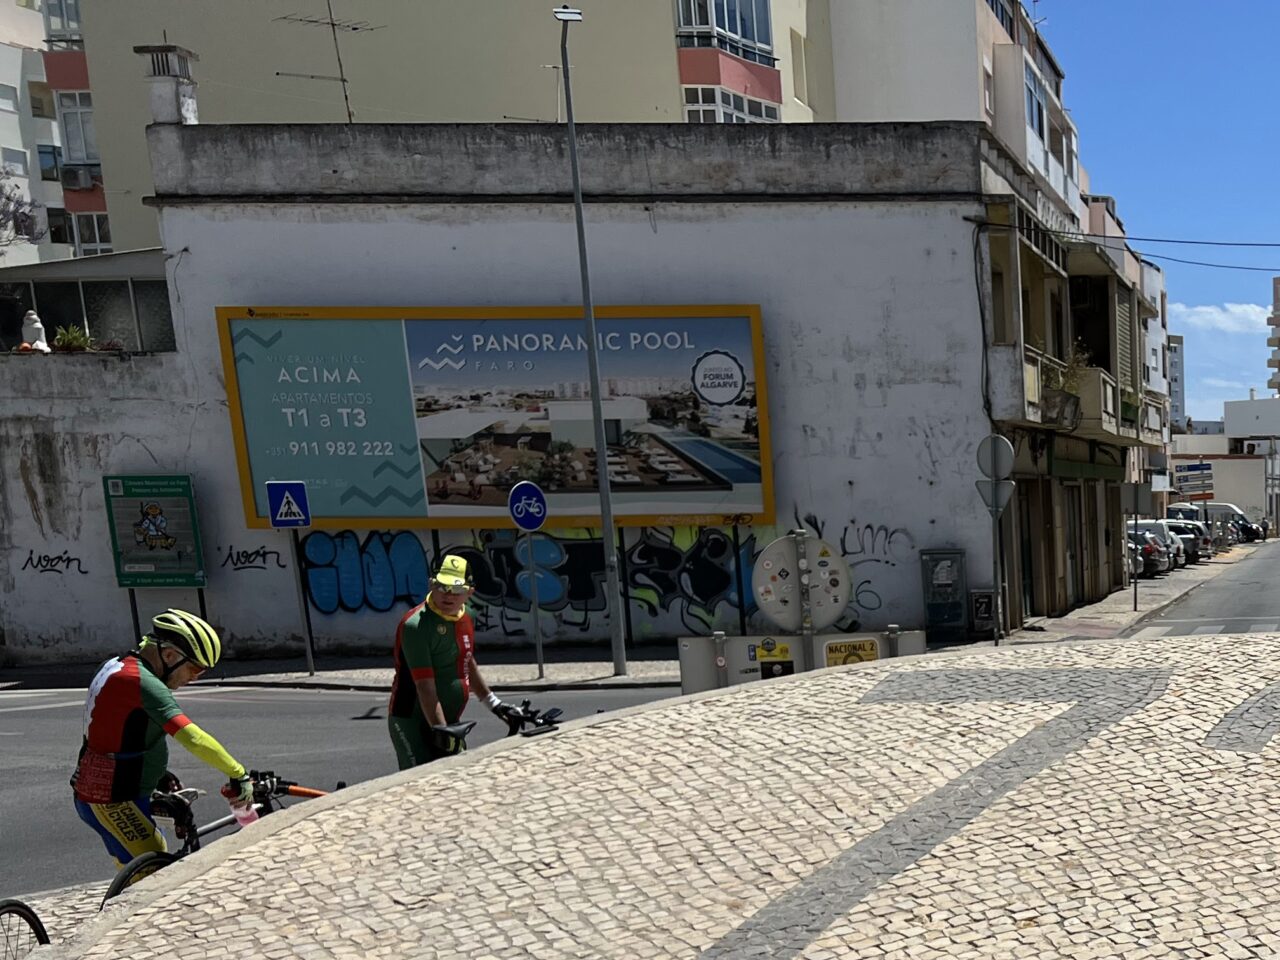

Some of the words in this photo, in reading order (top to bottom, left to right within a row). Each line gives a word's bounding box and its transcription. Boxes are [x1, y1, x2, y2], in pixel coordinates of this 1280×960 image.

[630, 331, 696, 350] POOL
[475, 360, 535, 371] FARO
[278, 366, 361, 383] ACIMA
[703, 373, 734, 381] FORUM
[700, 381, 739, 389] ALGARVE
[271, 392, 373, 405] APARTAMENTOS
[282, 408, 309, 427] T1
[319, 413, 332, 427] a
[337, 408, 367, 427] T3
[289, 441, 320, 456] 911
[326, 441, 357, 456] 982
[363, 441, 395, 456] 222
[828, 643, 867, 654] NACIONAL
[869, 642, 875, 651] 2
[108, 811, 139, 842] CYCLES
[120, 806, 152, 841] CAHABA
